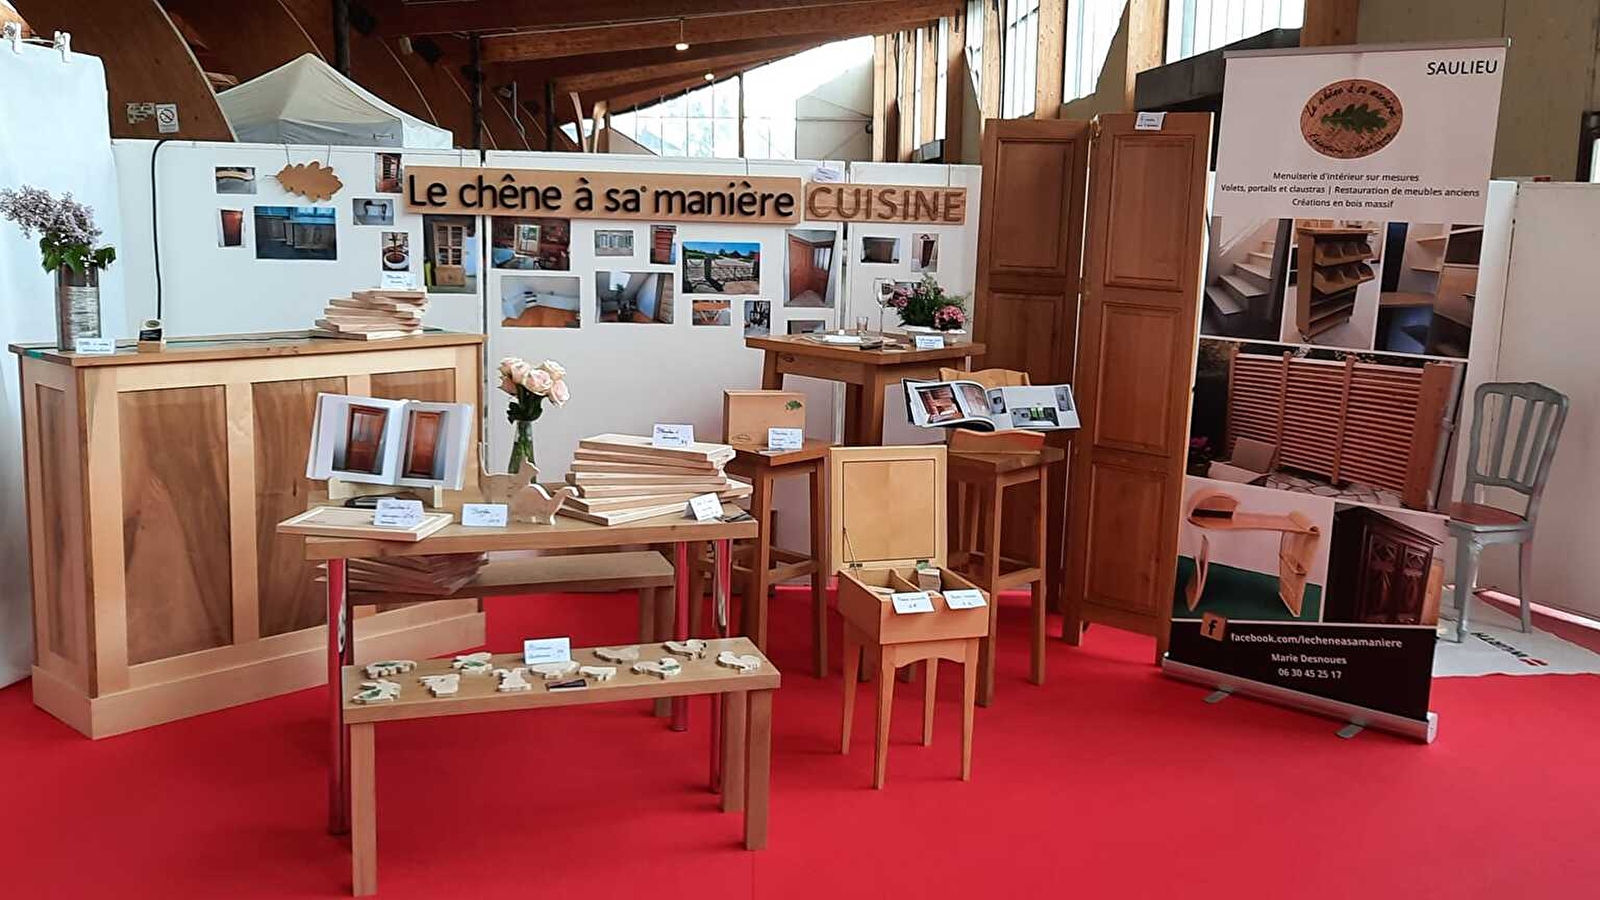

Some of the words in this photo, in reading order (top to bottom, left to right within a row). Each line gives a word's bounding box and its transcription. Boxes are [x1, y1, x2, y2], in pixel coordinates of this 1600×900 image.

[1426, 60, 1498, 75] SAULIEU
[1273, 172, 1318, 180] Menuiserie
[1319, 173, 1364, 181] d'intérieur
[408, 174, 448, 206] Le
[458, 173, 562, 210] chêne
[574, 176, 593, 212] à
[653, 180, 795, 217] manière
[1221, 184, 1247, 192] Volets,
[1248, 184, 1277, 193] portails
[1289, 185, 1325, 193] claustras
[1334, 186, 1389, 195] Restauration
[1391, 187, 1402, 195] de
[1404, 187, 1442, 196] meubles
[1444, 189, 1480, 197] anciens
[808, 186, 965, 222] CUISINE
[1292, 198, 1330, 207] Créations
[1345, 199, 1362, 208] bois
[1364, 200, 1394, 208] massif
[1230, 632, 1403, 648] facebook.com/lecheneasamaniere
[1271, 653, 1298, 663] Marie
[1300, 654, 1348, 665] Desnoues
[1278, 668, 1289, 677] 06
[1291, 668, 1303, 678] 30
[1304, 669, 1316, 678] 45
[1317, 669, 1329, 679] 25
[1331, 670, 1342, 679] 17
